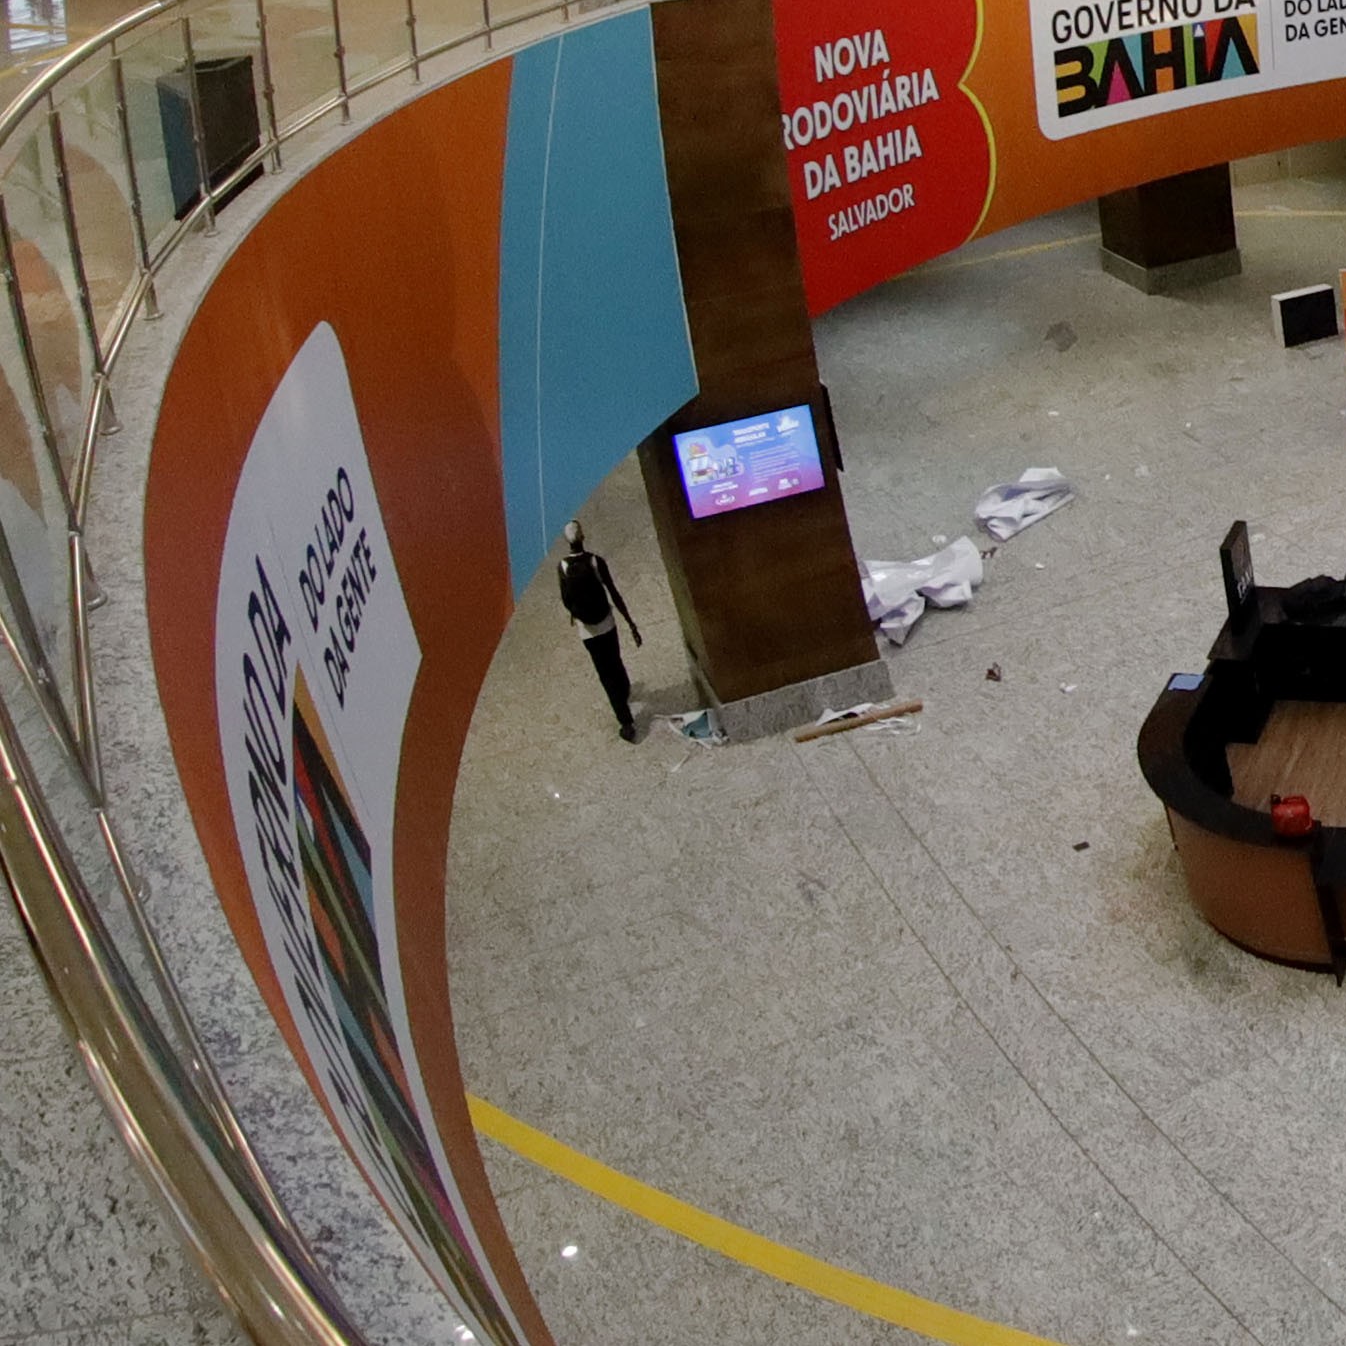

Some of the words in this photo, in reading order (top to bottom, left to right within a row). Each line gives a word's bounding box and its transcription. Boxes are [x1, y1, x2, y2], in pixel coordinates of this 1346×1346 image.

[813, 29, 890, 83] NOVA
[1053, 13, 1260, 118] BAHIA
[1285, 21, 1311, 42] DA
[781, 68, 940, 150] RODOVIÁRIA
[803, 154, 842, 200] DA
[843, 125, 923, 183] BAHIA
[828, 184, 916, 241] SALVADOR
[299, 543, 325, 634] DO
[314, 466, 355, 580] LADO
[336, 526, 378, 654] GENTE
[247, 553, 292, 720] DA
[324, 626, 351, 711] DA
